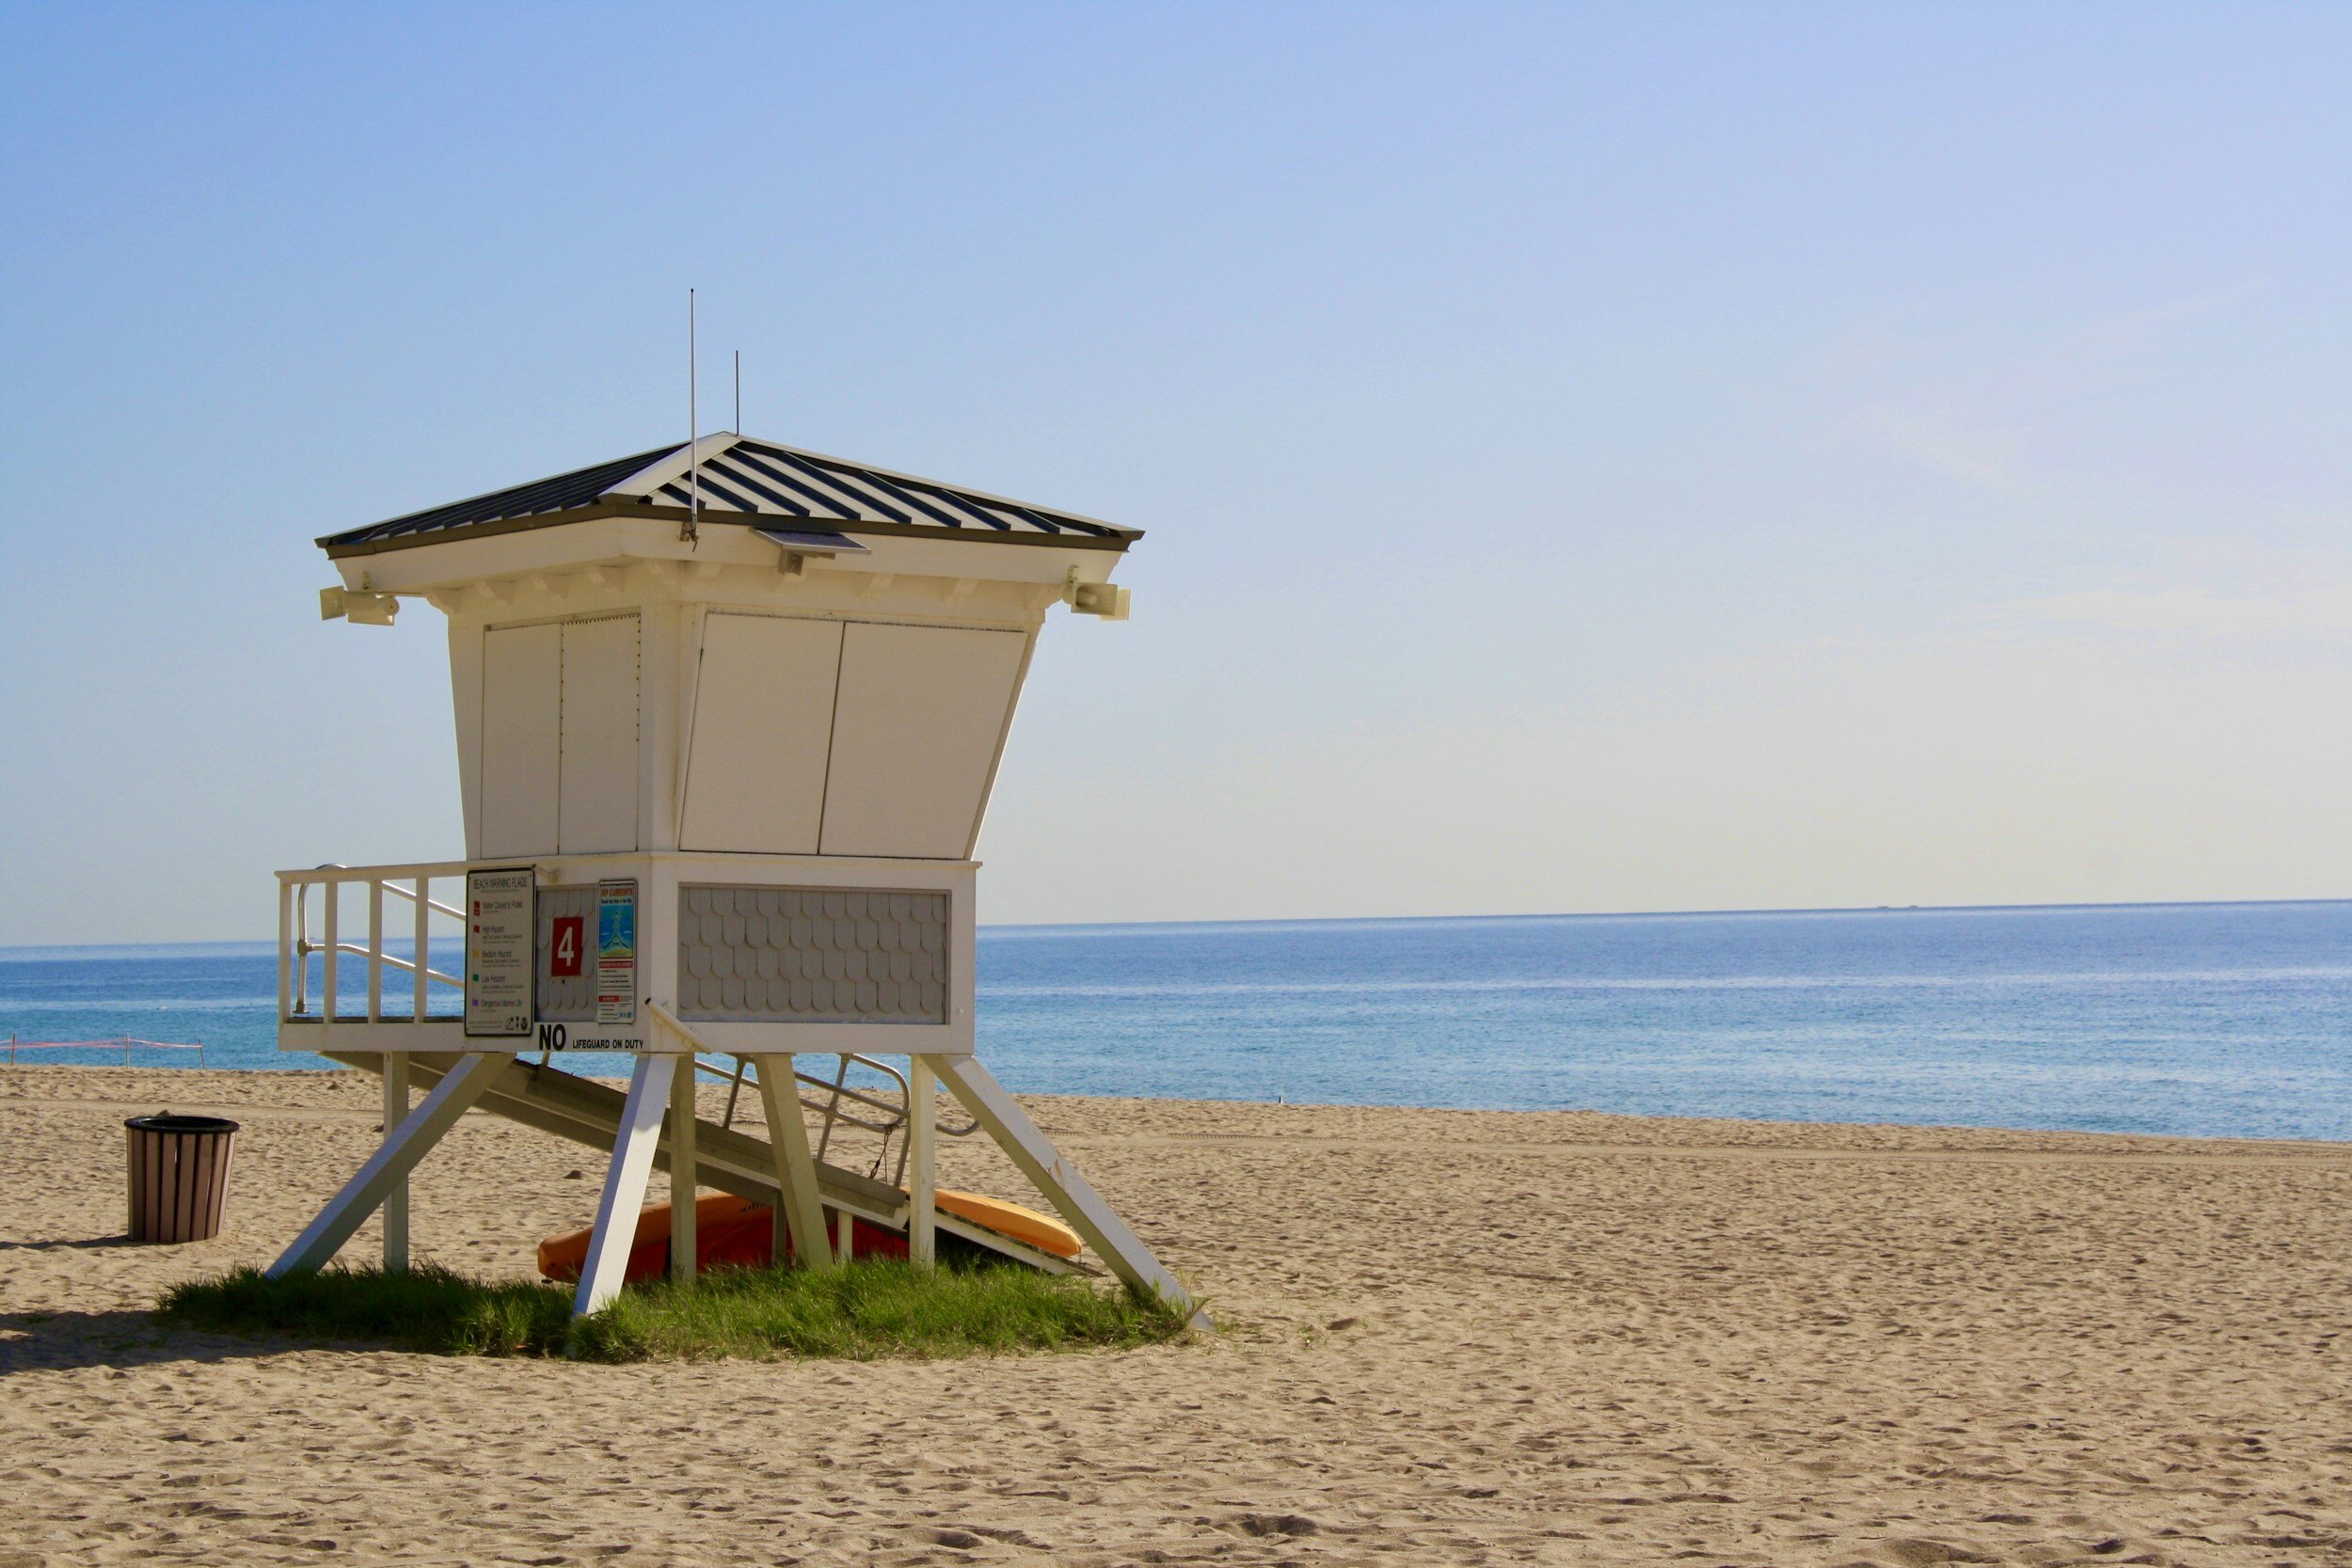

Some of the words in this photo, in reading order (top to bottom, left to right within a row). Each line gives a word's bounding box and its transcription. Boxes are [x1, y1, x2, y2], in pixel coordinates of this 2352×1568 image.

[473, 879, 489, 890] BEACH
[490, 878, 510, 889] WARNING
[511, 877, 527, 888] FLAGS
[558, 927, 574, 966] 4
[481, 999, 501, 1008] Dangerous
[539, 1024, 566, 1051] NO
[572, 1039, 610, 1049] LIFEGUARD
[612, 1039, 622, 1048] ON
[625, 1039, 644, 1048] DUTY
